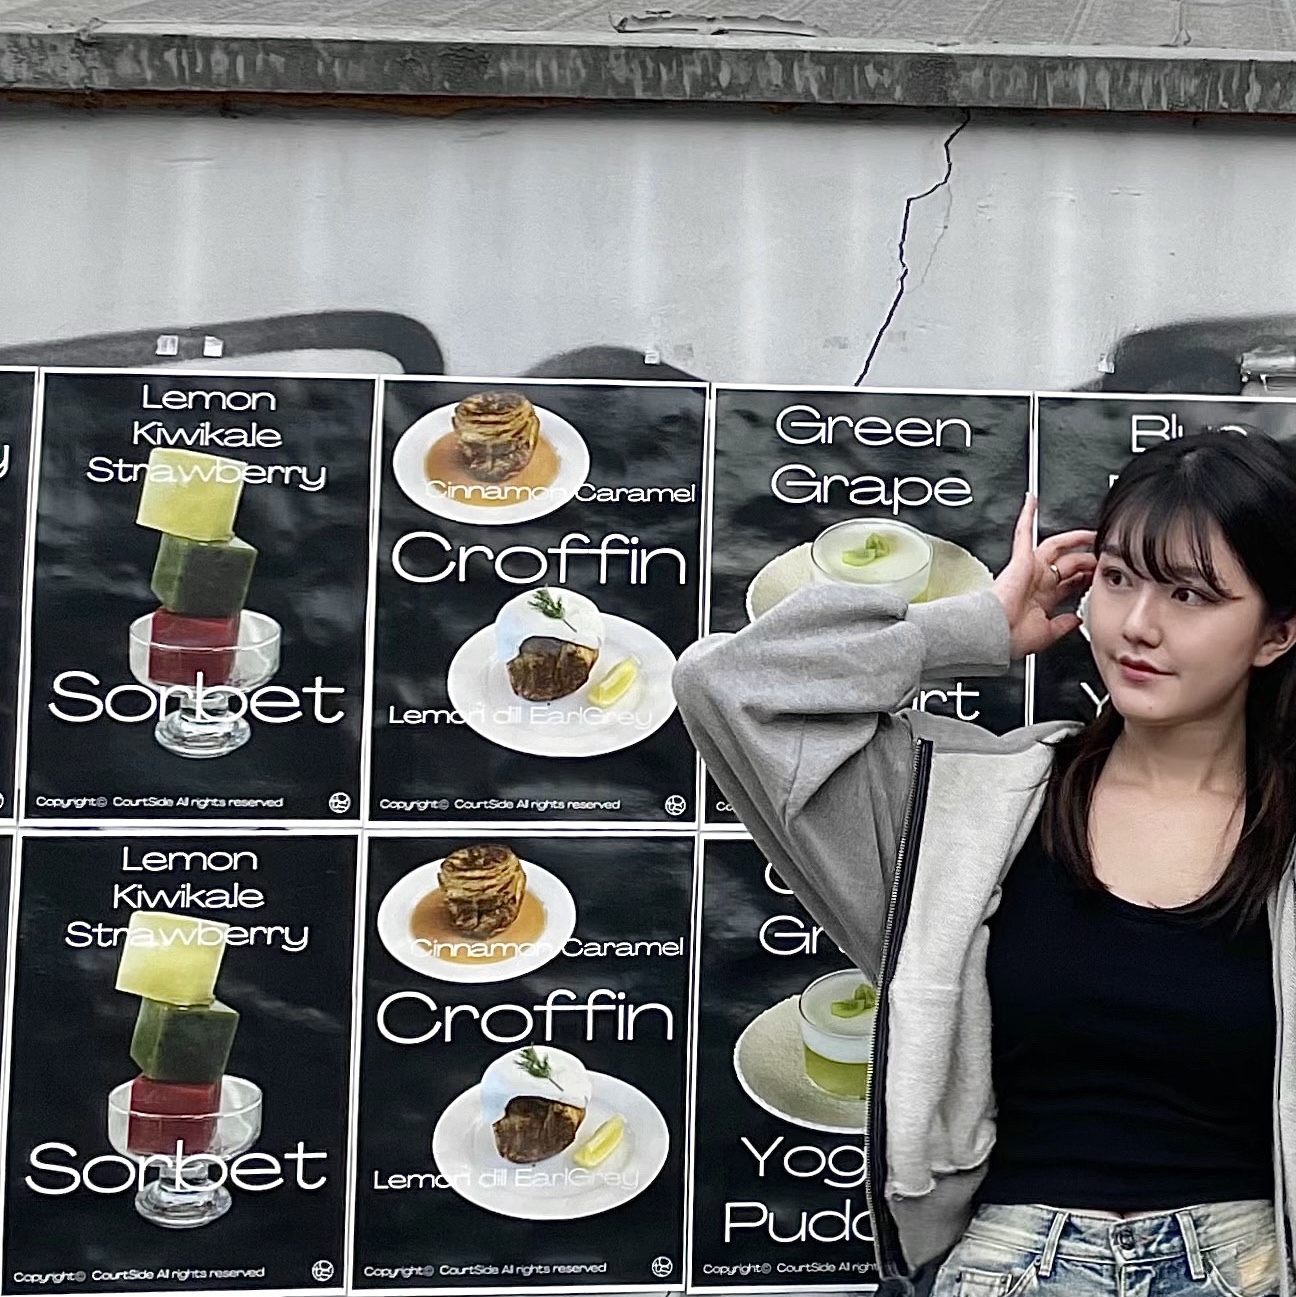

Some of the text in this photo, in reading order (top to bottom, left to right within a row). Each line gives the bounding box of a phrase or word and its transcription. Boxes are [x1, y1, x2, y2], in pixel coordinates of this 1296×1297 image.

[142, 385, 275, 411] Lemon
[133, 421, 282, 448] Kiwikale
[775, 405, 972, 448] Green
[87, 457, 327, 491] Strawberry
[426, 480, 696, 503] Cinnamon Caramel
[770, 464, 974, 516] Grape
[392, 531, 686, 585] Croffin
[48, 670, 344, 724] Sorbet
[389, 704, 485, 724] Lemon
[176, 796, 189, 806] All
[191, 796, 226, 810] rights
[228, 797, 284, 807] reserved
[516, 798, 529, 809] All
[531, 798, 565, 811] rights
[567, 799, 621, 809] reserved
[122, 846, 257, 872] Lemon
[113, 883, 265, 910] Kiwikale
[65, 921, 309, 952] Strawberry
[411, 936, 684, 958] Cinnamon Caramel
[377, 989, 673, 1045] Croffin
[25, 1139, 327, 1195] Sorbet
[374, 1167, 639, 1193] Lemon dill EarlGrey
[156, 1268, 170, 1279] All
[171, 1268, 207, 1281] rights
[209, 1267, 265, 1278] reserved
[502, 1264, 514, 1274] All
[516, 1263, 550, 1277] rights
[552, 1262, 607, 1273] reserved
[839, 1262, 850, 1272] All
[852, 1262, 878, 1274] right
